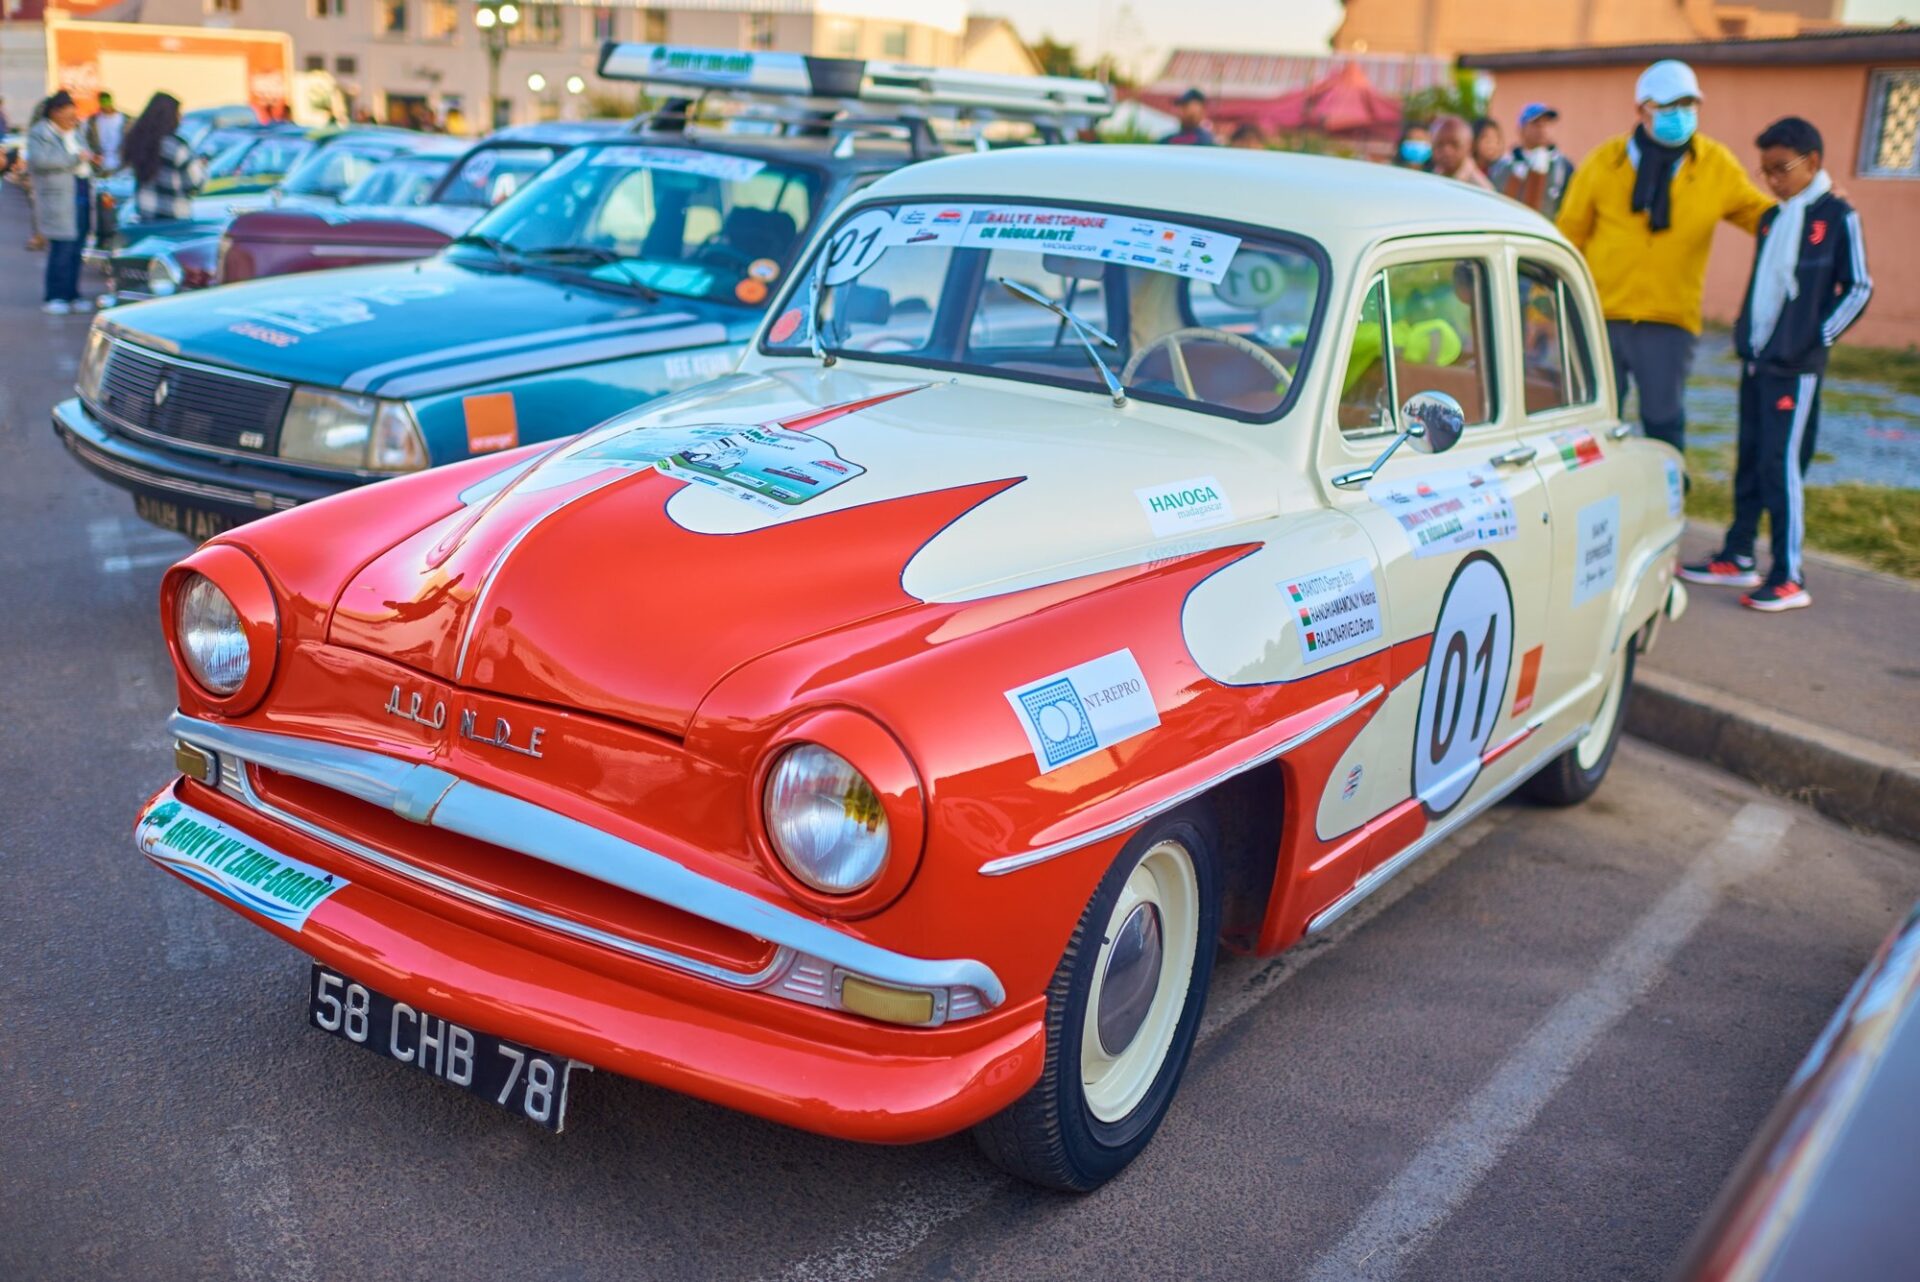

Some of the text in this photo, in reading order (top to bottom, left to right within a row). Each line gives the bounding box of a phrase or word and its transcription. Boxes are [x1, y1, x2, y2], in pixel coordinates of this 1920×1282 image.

[980, 227, 997, 239] DE
[987, 212, 1108, 229] RALLYE HISTORIQUE
[828, 226, 882, 268] 01
[1149, 486, 1219, 513] HAVOGA
[1177, 502, 1223, 519] madagascar
[1298, 576, 1327, 598] RAKOTO
[1359, 618, 1375, 635] Bruno
[1083, 678, 1141, 711] NT-REPRO
[1430, 613, 1497, 765] 01
[384, 685, 546, 758] ARONDE
[204, 838, 246, 868] NY
[223, 847, 336, 910] ZAVA-BOARY
[316, 971, 554, 1123] 58 CHB 78
